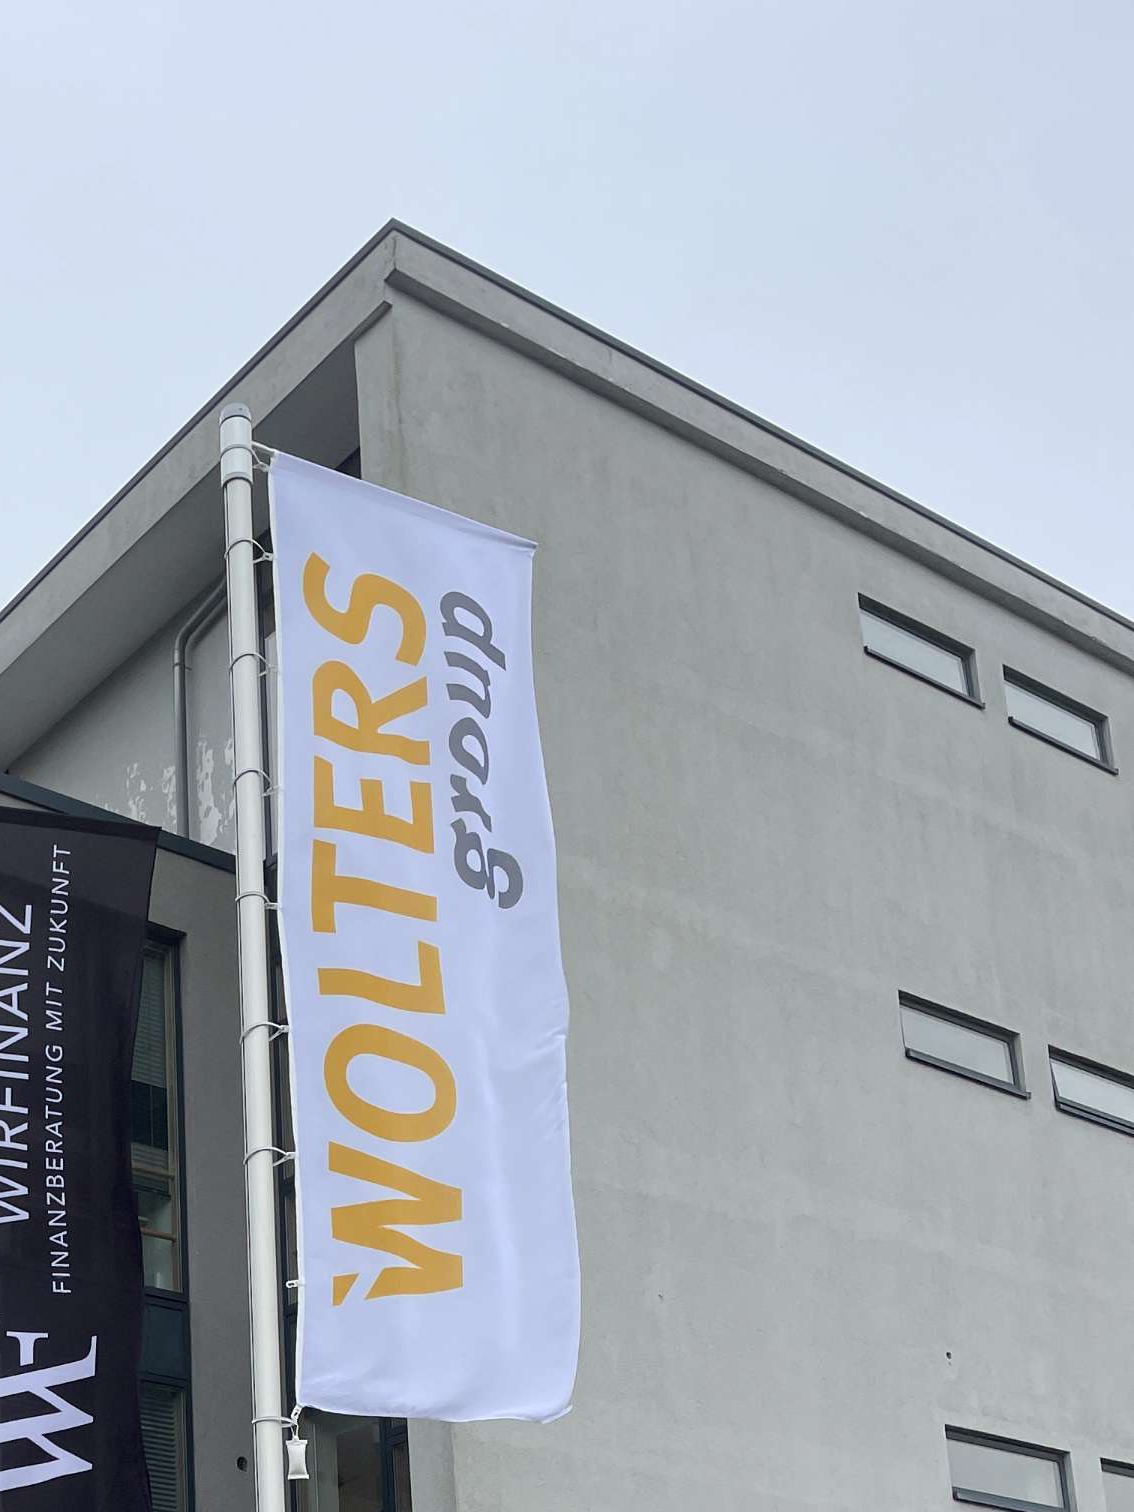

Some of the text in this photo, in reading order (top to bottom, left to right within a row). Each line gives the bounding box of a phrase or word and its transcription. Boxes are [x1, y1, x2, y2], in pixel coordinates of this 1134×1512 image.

[304, 555, 462, 1306] WOLTERS
[439, 591, 524, 910] group
[45, 844, 72, 1294] FINANZBERATUNG MIT ZUKUNFT
